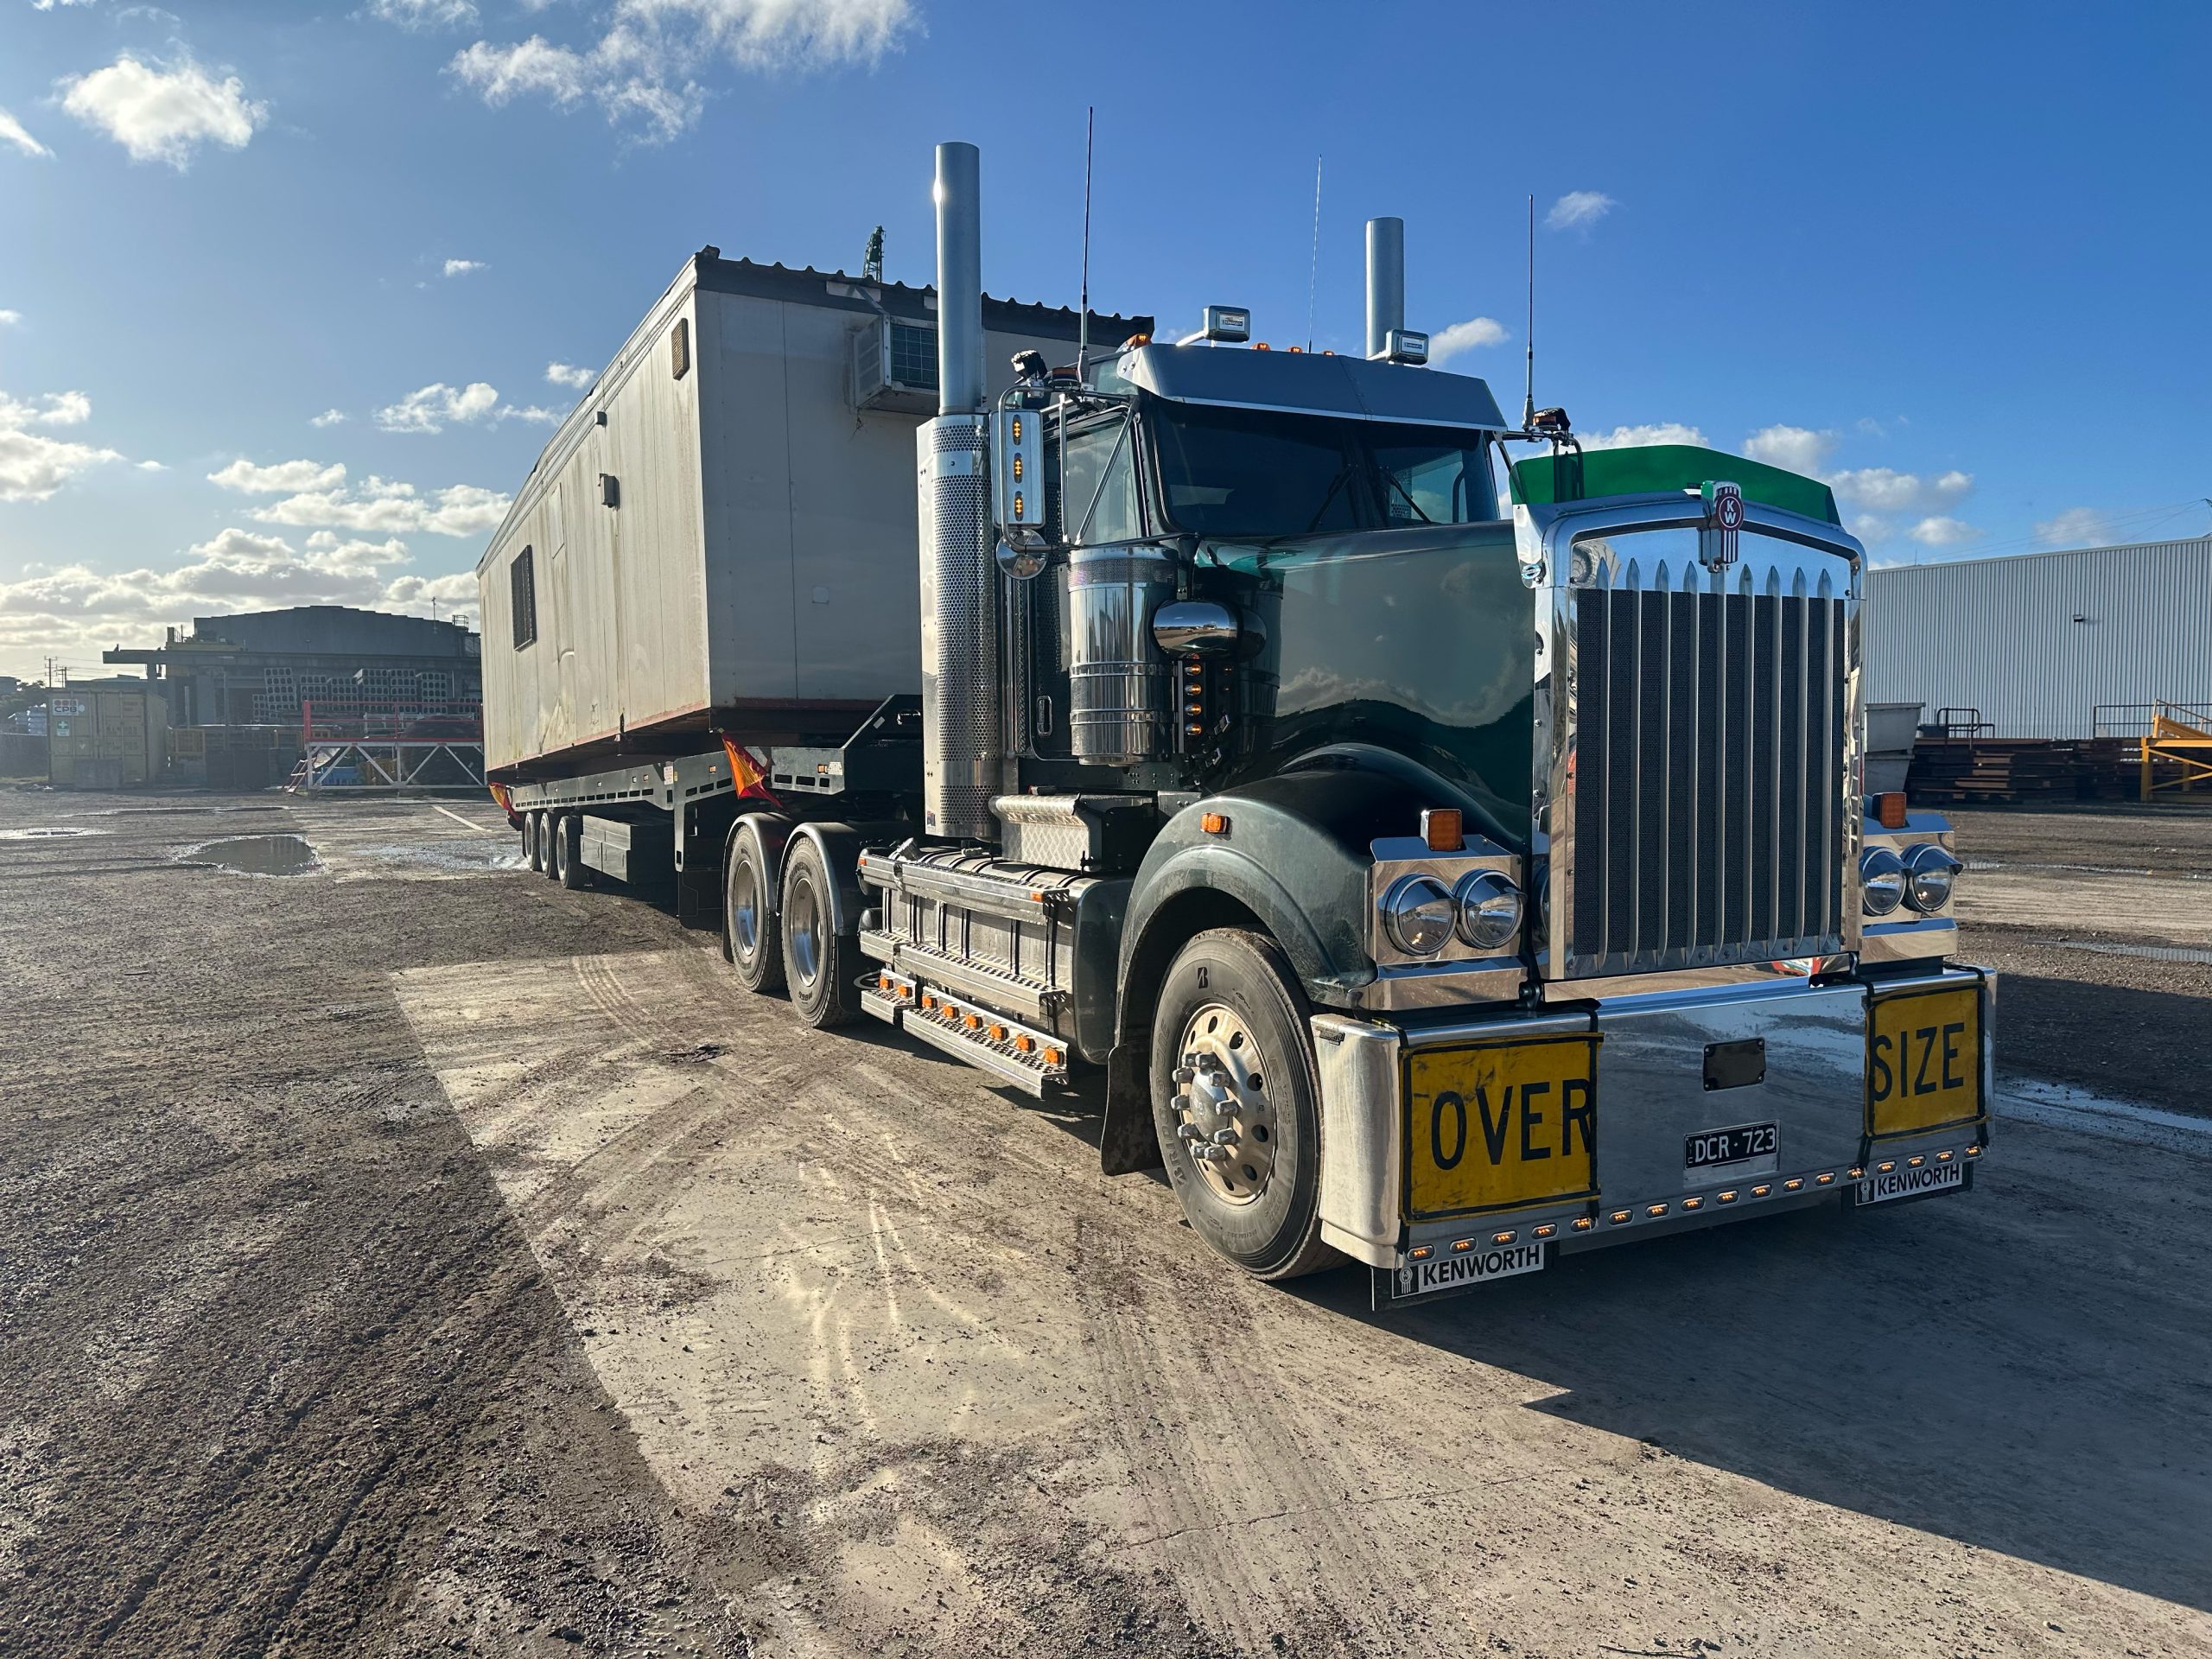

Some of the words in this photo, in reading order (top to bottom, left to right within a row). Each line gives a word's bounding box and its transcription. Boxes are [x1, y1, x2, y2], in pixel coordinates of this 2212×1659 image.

[1872, 1021, 1965, 1102] SIZE
[1431, 1078, 1592, 1171] OVER
[1878, 1163, 1960, 1196] KENWORTH
[1423, 1243, 1540, 1287] KENWORTH
